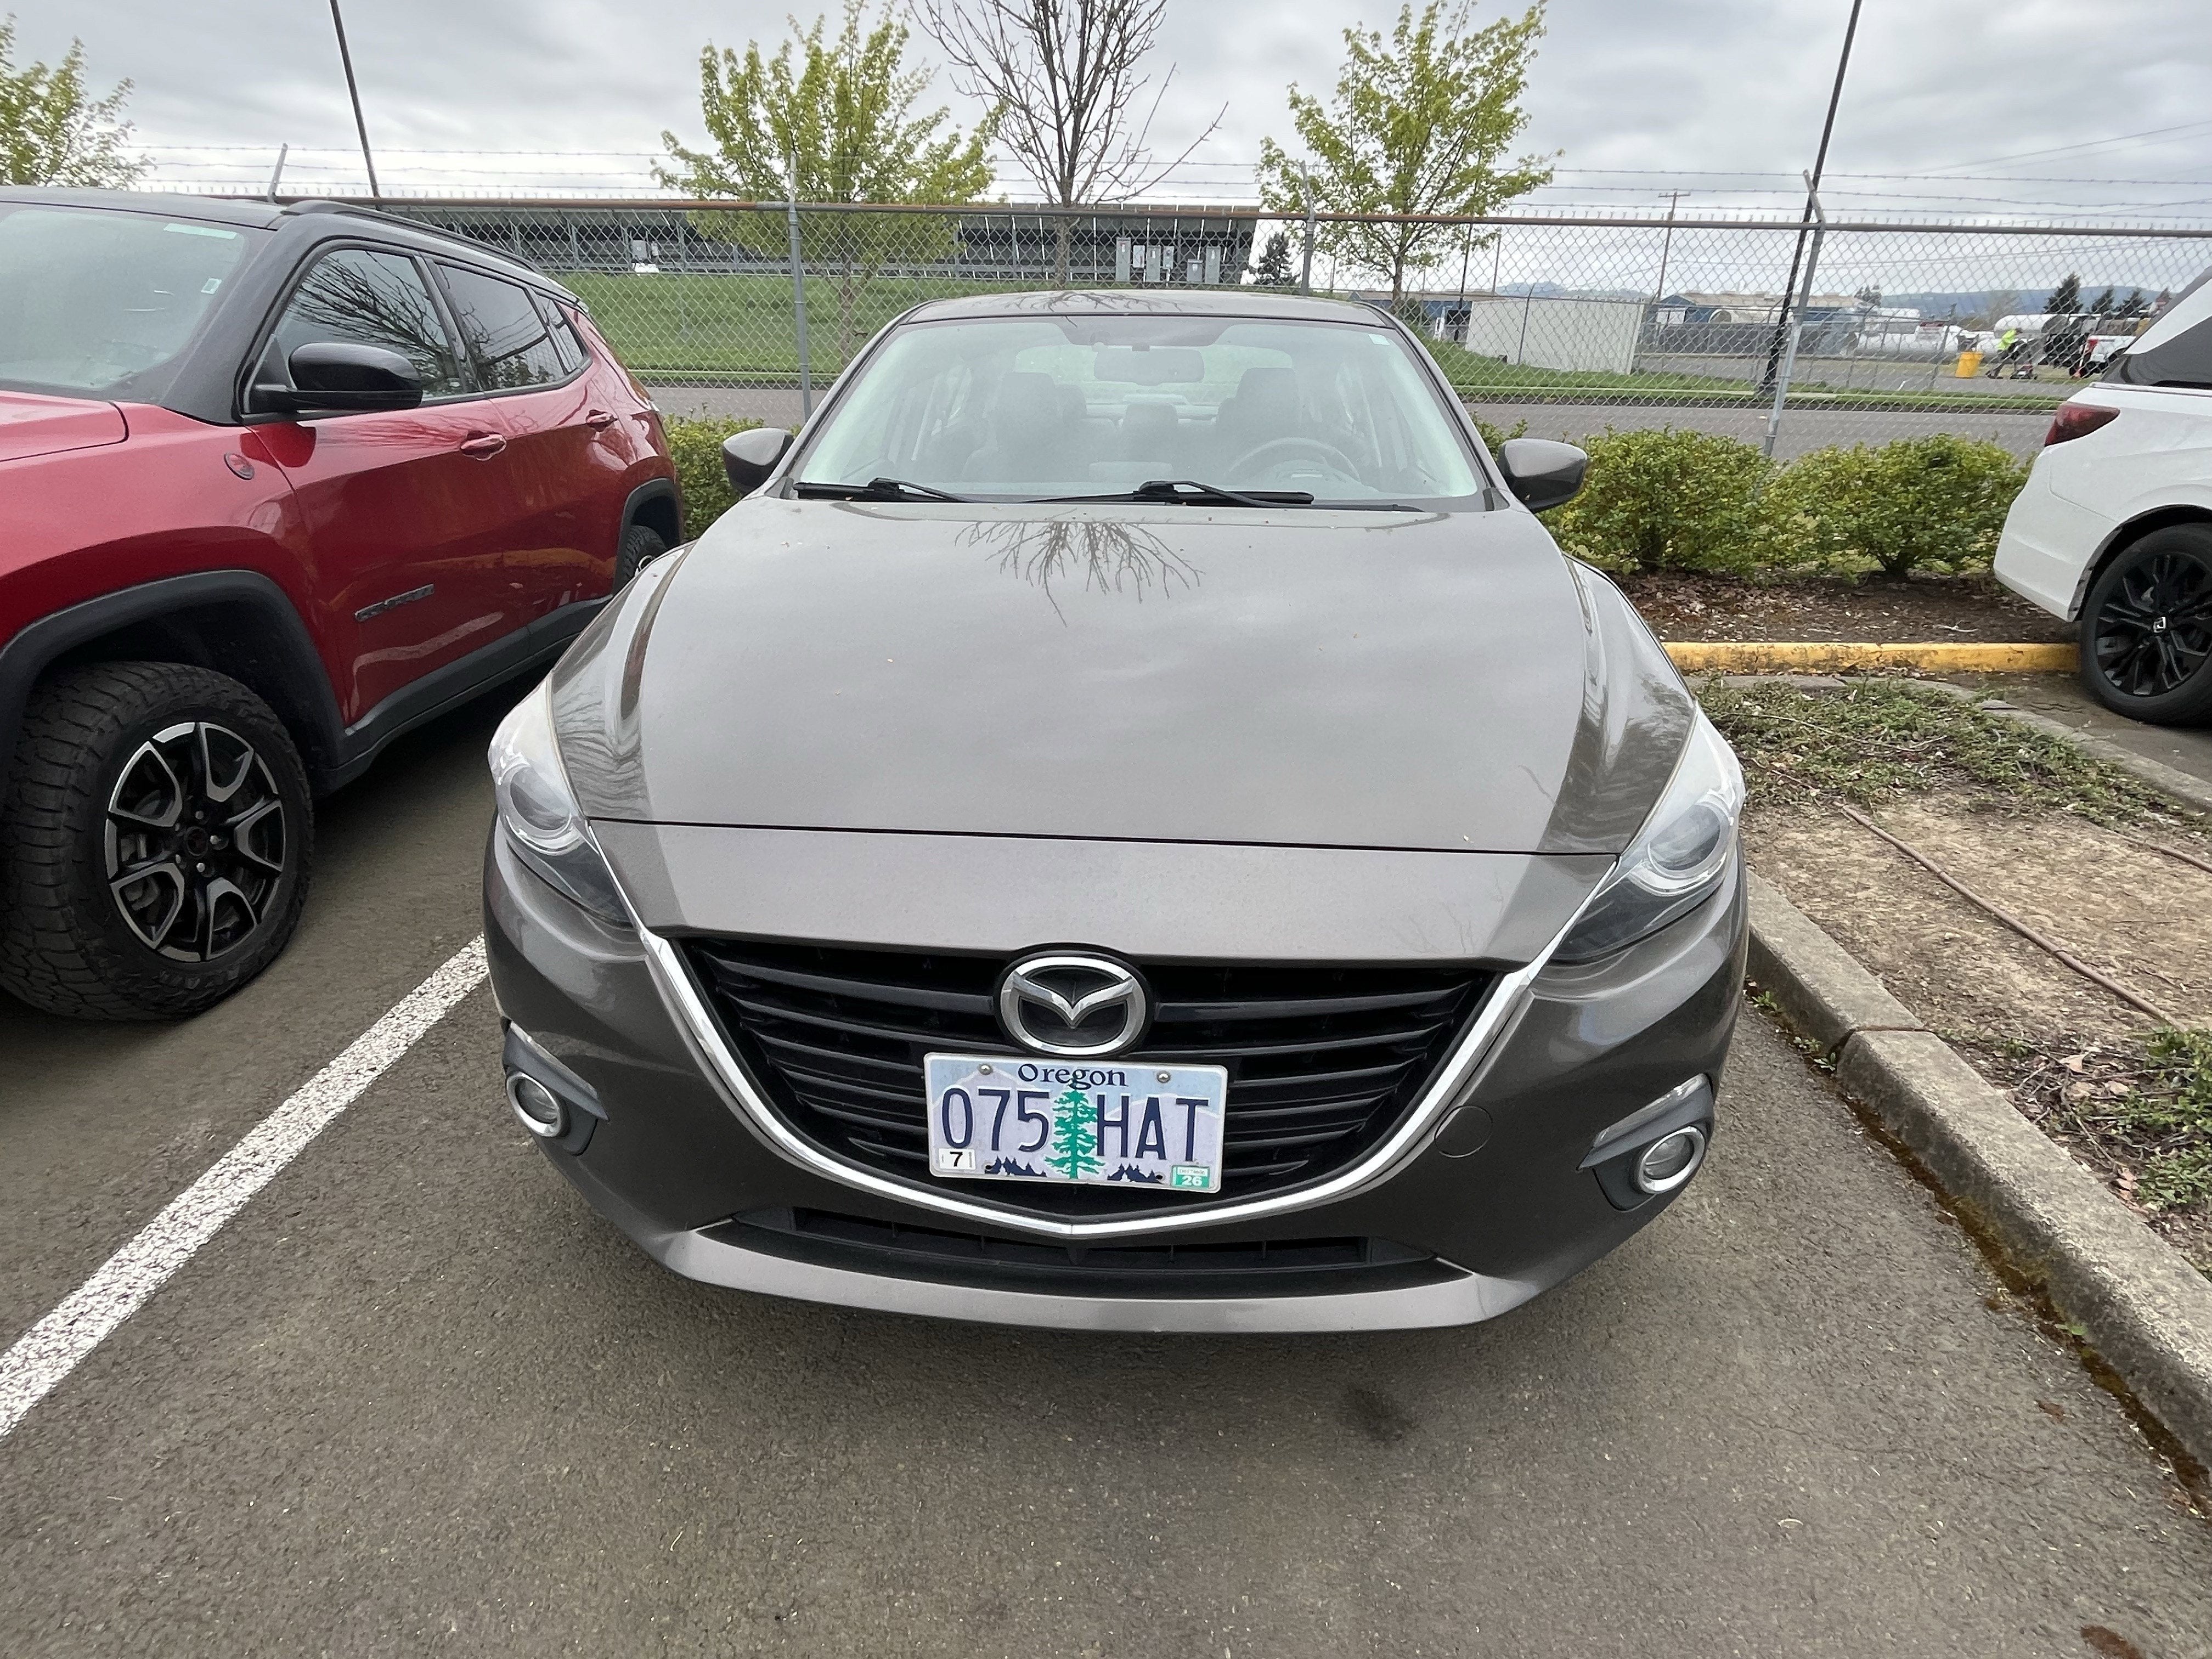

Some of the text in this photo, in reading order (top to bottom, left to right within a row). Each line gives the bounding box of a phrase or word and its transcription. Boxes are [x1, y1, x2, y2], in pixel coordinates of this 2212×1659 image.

[1018, 1064, 1128, 1090] Oregon
[941, 1087, 1209, 1162] 075 HAT
[950, 1151, 963, 1167] 7
[1182, 1175, 1203, 1186] 26
